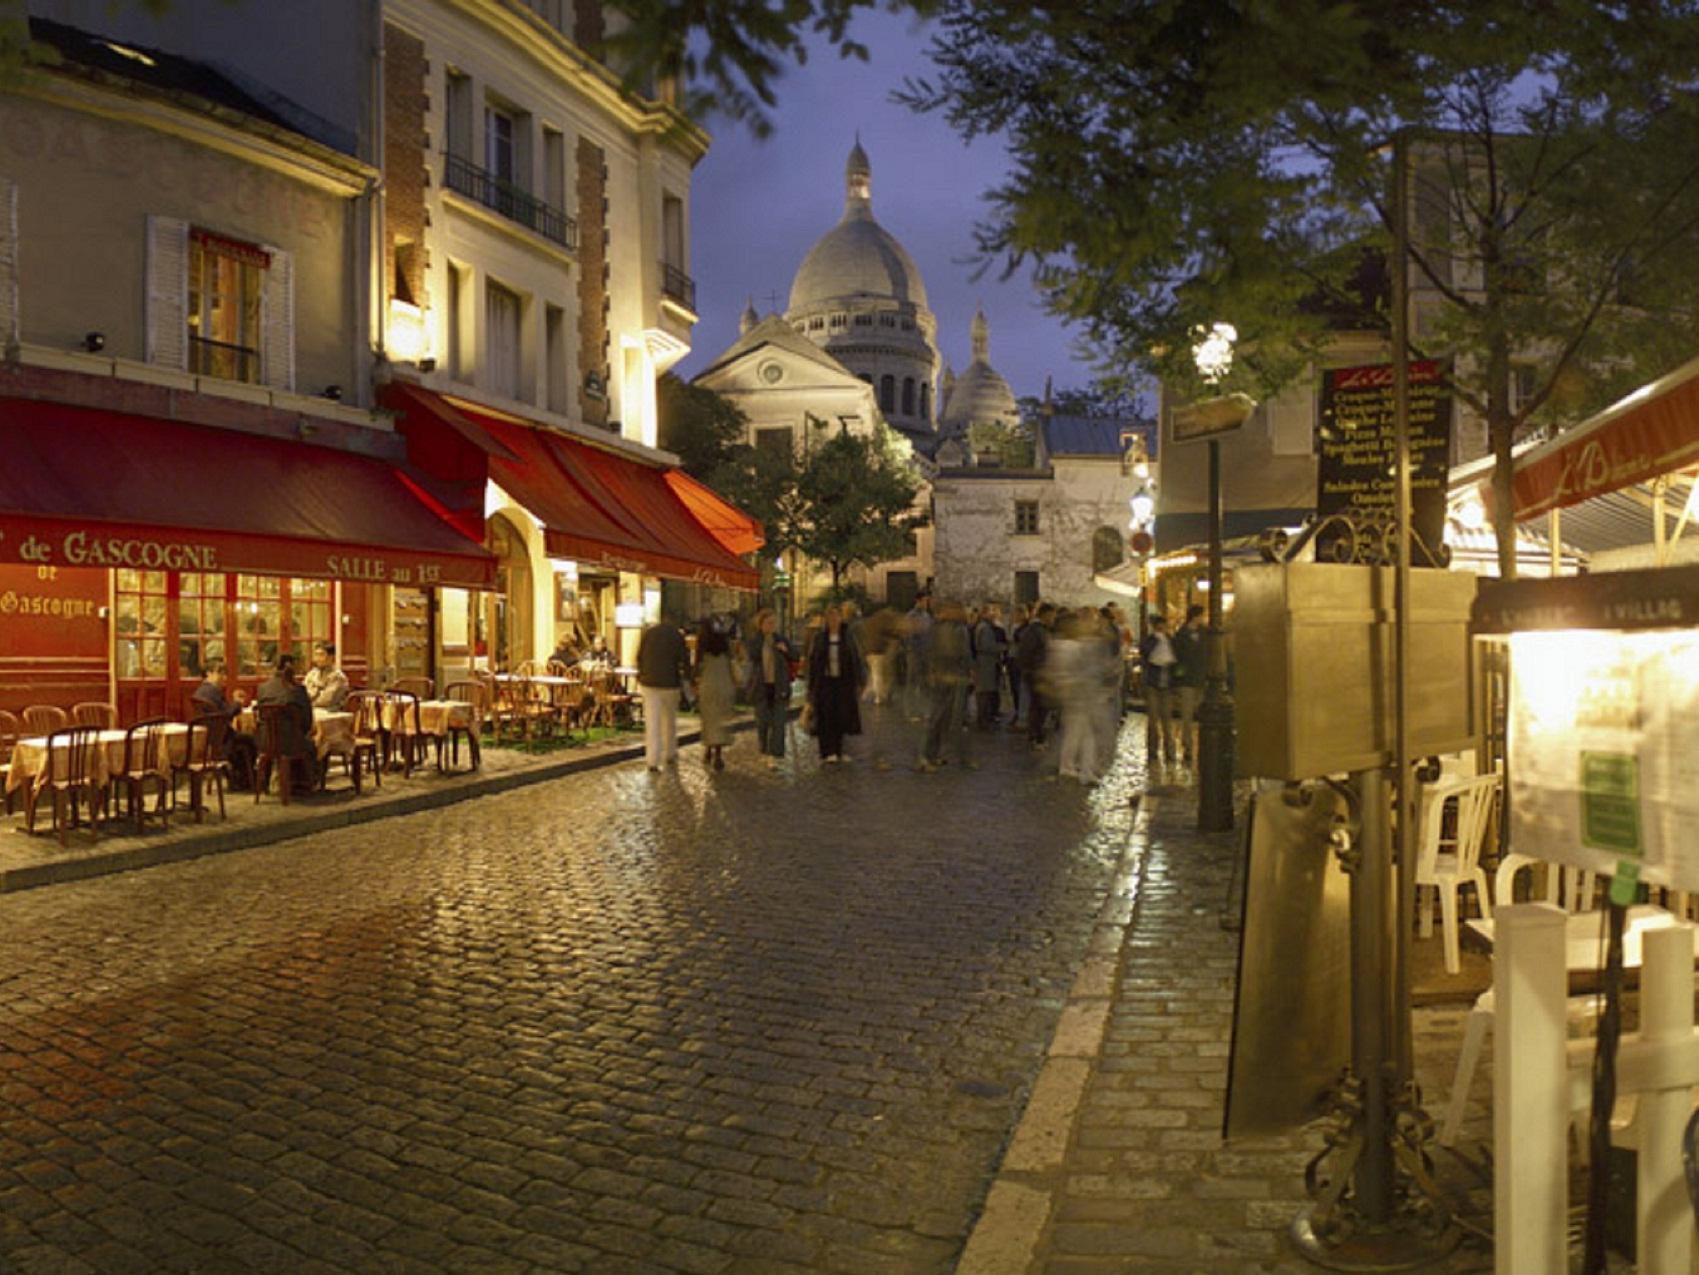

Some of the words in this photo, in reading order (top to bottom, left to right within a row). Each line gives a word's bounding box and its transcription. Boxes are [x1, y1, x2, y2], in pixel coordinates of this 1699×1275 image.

[20, 535, 52, 561] de
[64, 531, 219, 569] GASCOGNE
[326, 555, 385, 579] SALLE
[392, 566, 411, 582] au
[1, 591, 95, 619] Gascogne
